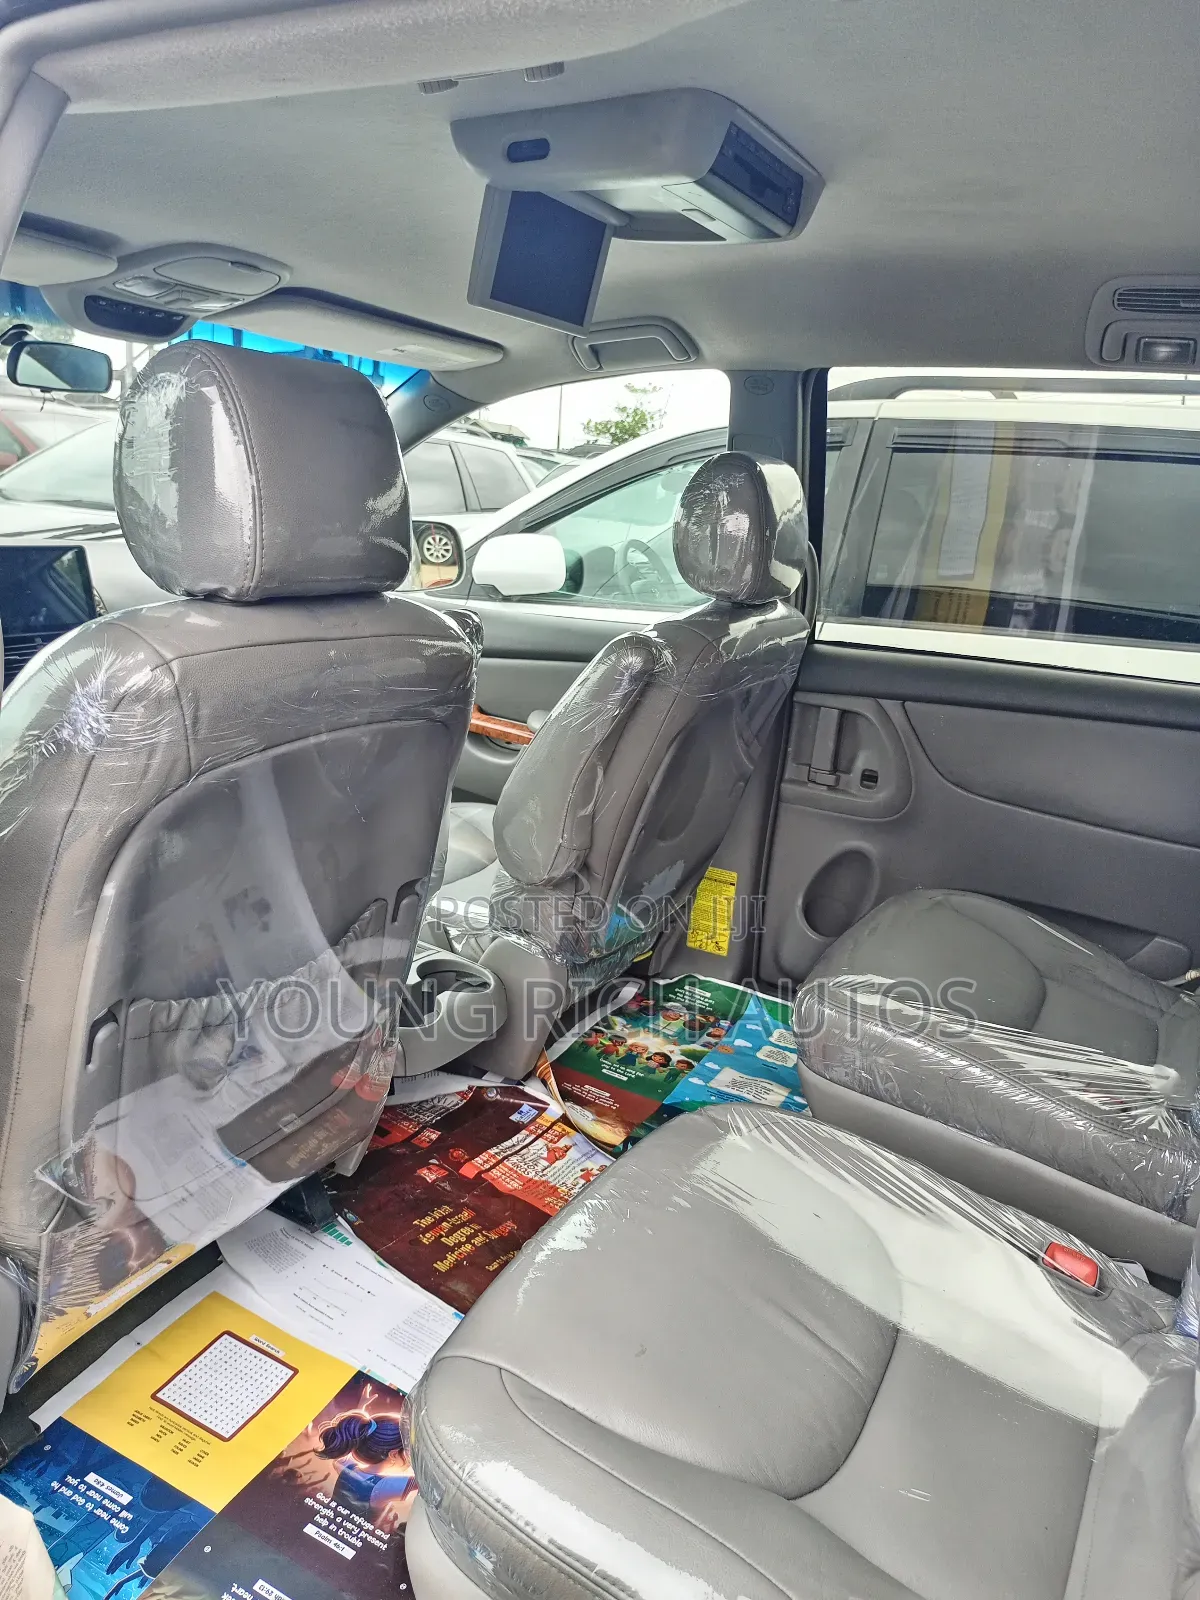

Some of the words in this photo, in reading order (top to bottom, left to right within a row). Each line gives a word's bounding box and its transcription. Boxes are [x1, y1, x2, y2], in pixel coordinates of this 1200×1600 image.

[441, 1223, 475, 1249] Degree
[433, 1240, 475, 1273] Medicine
[51, 1481, 61, 1492] he
[65, 1475, 80, 1486] you.
[58, 1486, 73, 1496] and
[78, 1484, 87, 1492] to
[105, 1485, 123, 1498] James
[70, 1494, 85, 1505] God
[86, 1490, 103, 1501] near
[85, 1502, 94, 1511] to
[102, 1499, 121, 1512] come
[93, 1508, 111, 1521] near
[118, 1510, 133, 1521] will
[316, 1492, 331, 1503] God
[337, 1506, 350, 1515] our
[350, 1513, 374, 1530] refuge
[375, 1529, 390, 1540] and
[110, 1518, 129, 1533] Come
[314, 1514, 329, 1527] help
[329, 1523, 337, 1531] in
[338, 1528, 362, 1547] trouble
[314, 1530, 332, 1544] Psalm
[333, 1542, 345, 1551] 46:1
[343, 1520, 360, 1534] very
[358, 1530, 387, 1550] present
